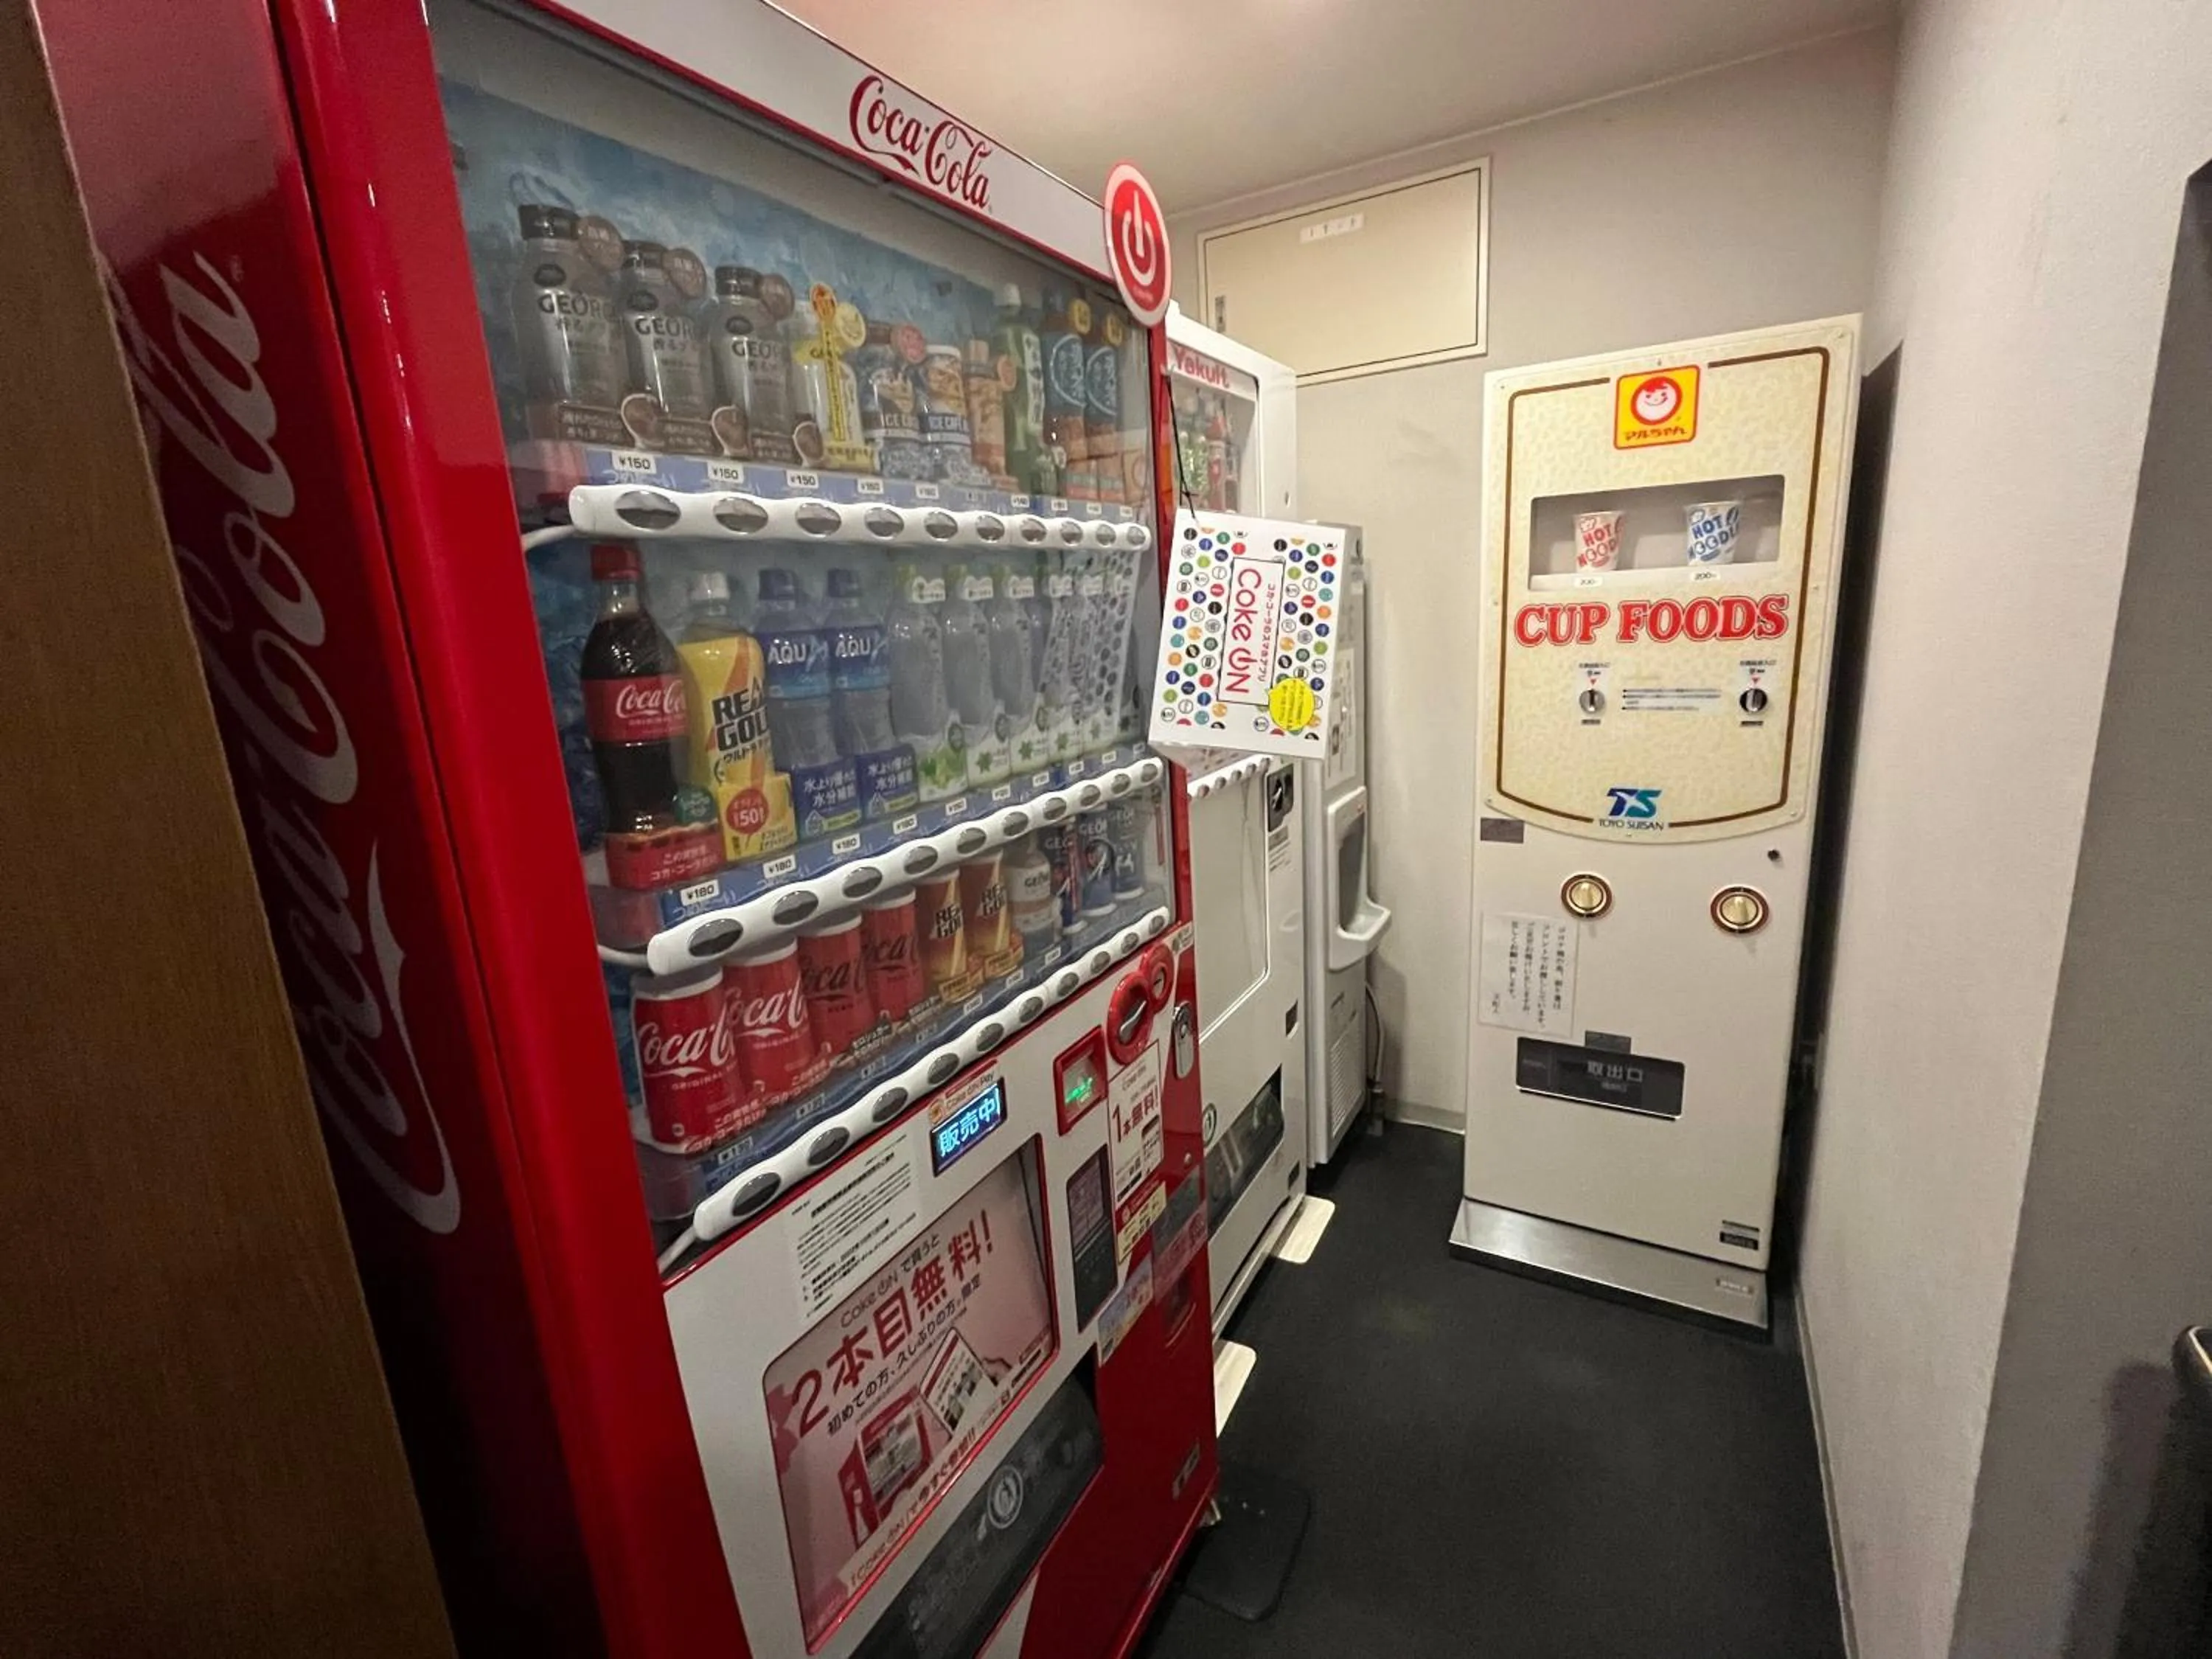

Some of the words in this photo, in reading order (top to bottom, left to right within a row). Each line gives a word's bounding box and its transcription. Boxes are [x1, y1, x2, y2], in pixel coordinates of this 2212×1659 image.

[849, 74, 992, 212] Coca-Cola
[1173, 343, 1229, 389] Yakult
[790, 474, 815, 486] ¥150
[1582, 524, 1613, 547] HOT
[1691, 515, 1725, 539] HOT
[1232, 568, 1262, 641] Coke
[1514, 602, 1610, 647] CUP
[1616, 594, 1790, 644] FOODS
[1225, 647, 1258, 693] ON
[1599, 818, 1625, 827] TOYO
[1627, 819, 1664, 831] SUISAN
[768, 859, 792, 874] ¥180
[686, 884, 714, 900] ¥180
[1587, 1060, 1642, 1082] 取出口
[939, 1098, 995, 1157] 販売中
[841, 1292, 877, 1328] Coke
[877, 1270, 899, 1296] ON
[792, 1210, 993, 1438] 2本目無料!
